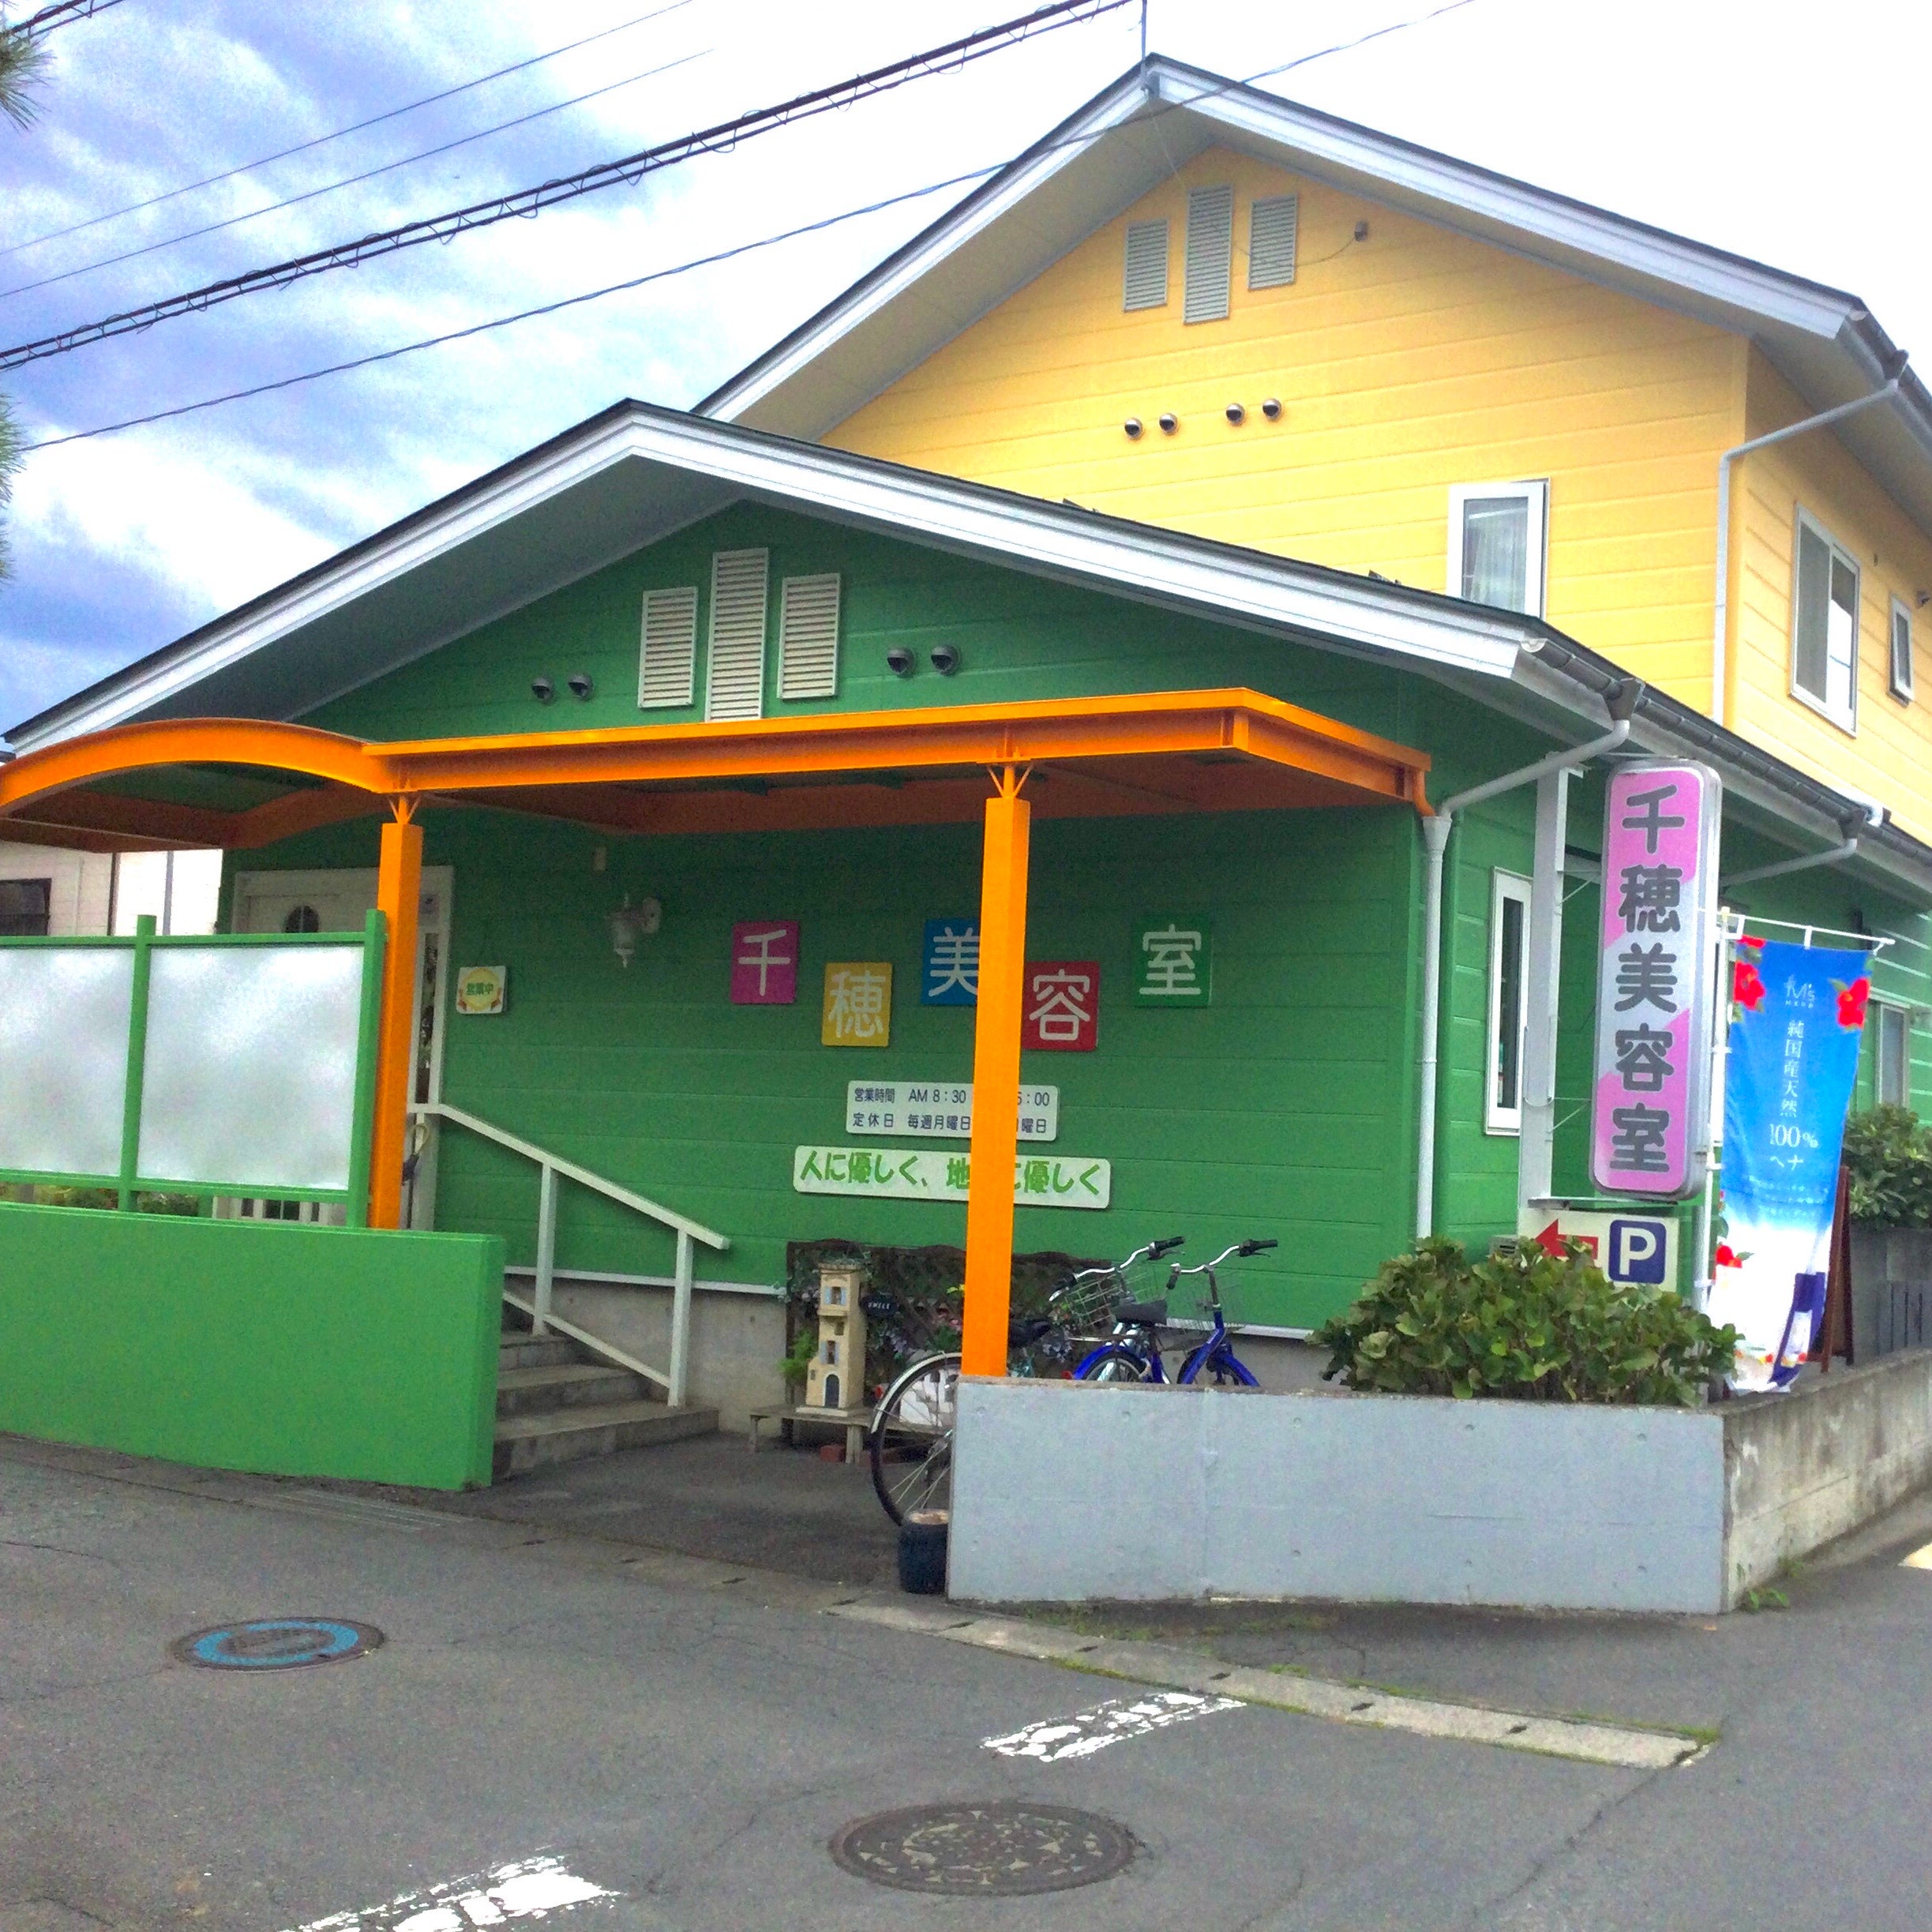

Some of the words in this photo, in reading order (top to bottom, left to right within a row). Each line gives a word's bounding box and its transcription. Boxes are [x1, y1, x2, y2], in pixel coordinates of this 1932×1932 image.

[1610, 784, 1685, 1172] 千穂美容室
[1780, 1019, 1804, 1117] 純国産天然
[854, 1087, 895, 1104] 営業時間
[909, 1089, 928, 1102] AM
[853, 1112, 894, 1128] 定休日
[1769, 1124, 1818, 1148] 100%
[1769, 1154, 1804, 1171] ヘナ
[1619, 1226, 1657, 1276] P
